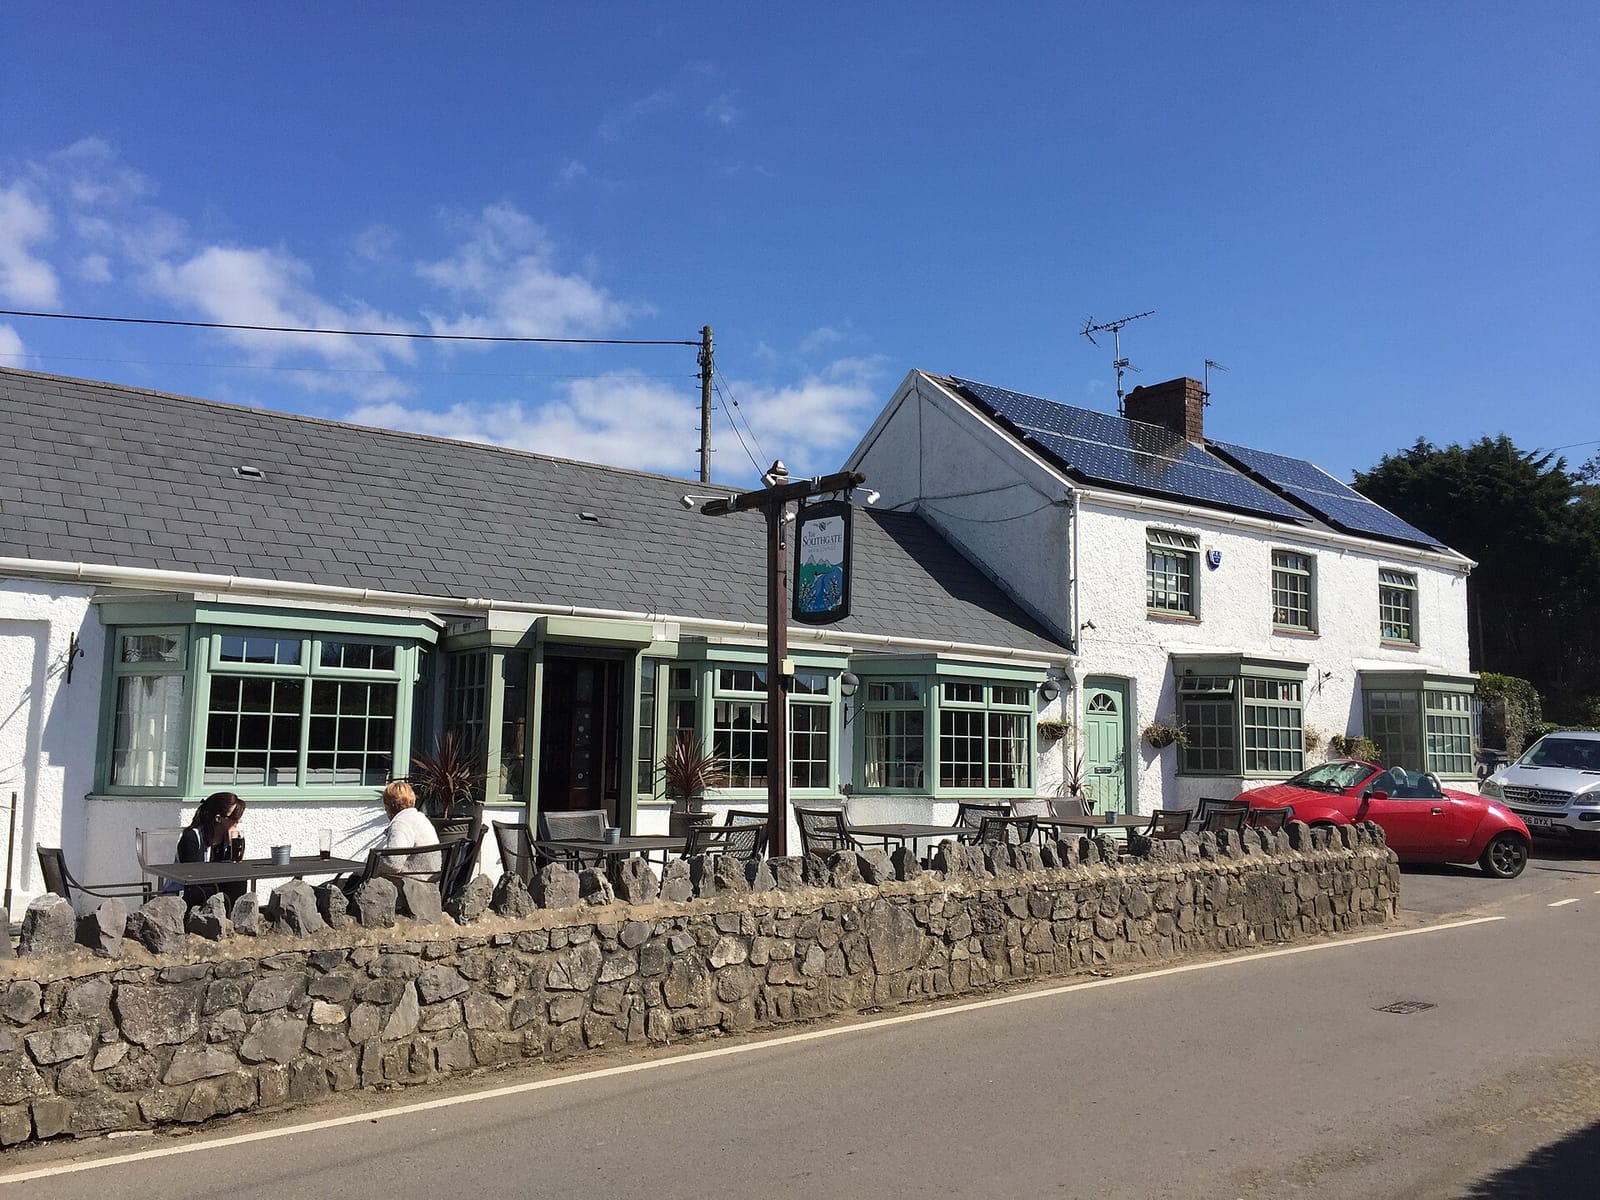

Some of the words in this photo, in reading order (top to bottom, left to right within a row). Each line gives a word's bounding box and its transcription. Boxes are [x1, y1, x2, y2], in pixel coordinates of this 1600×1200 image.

[803, 534, 843, 547] SOUTHGATE
[1521, 815, 1533, 824] 56
[1534, 816, 1549, 826] DYX
